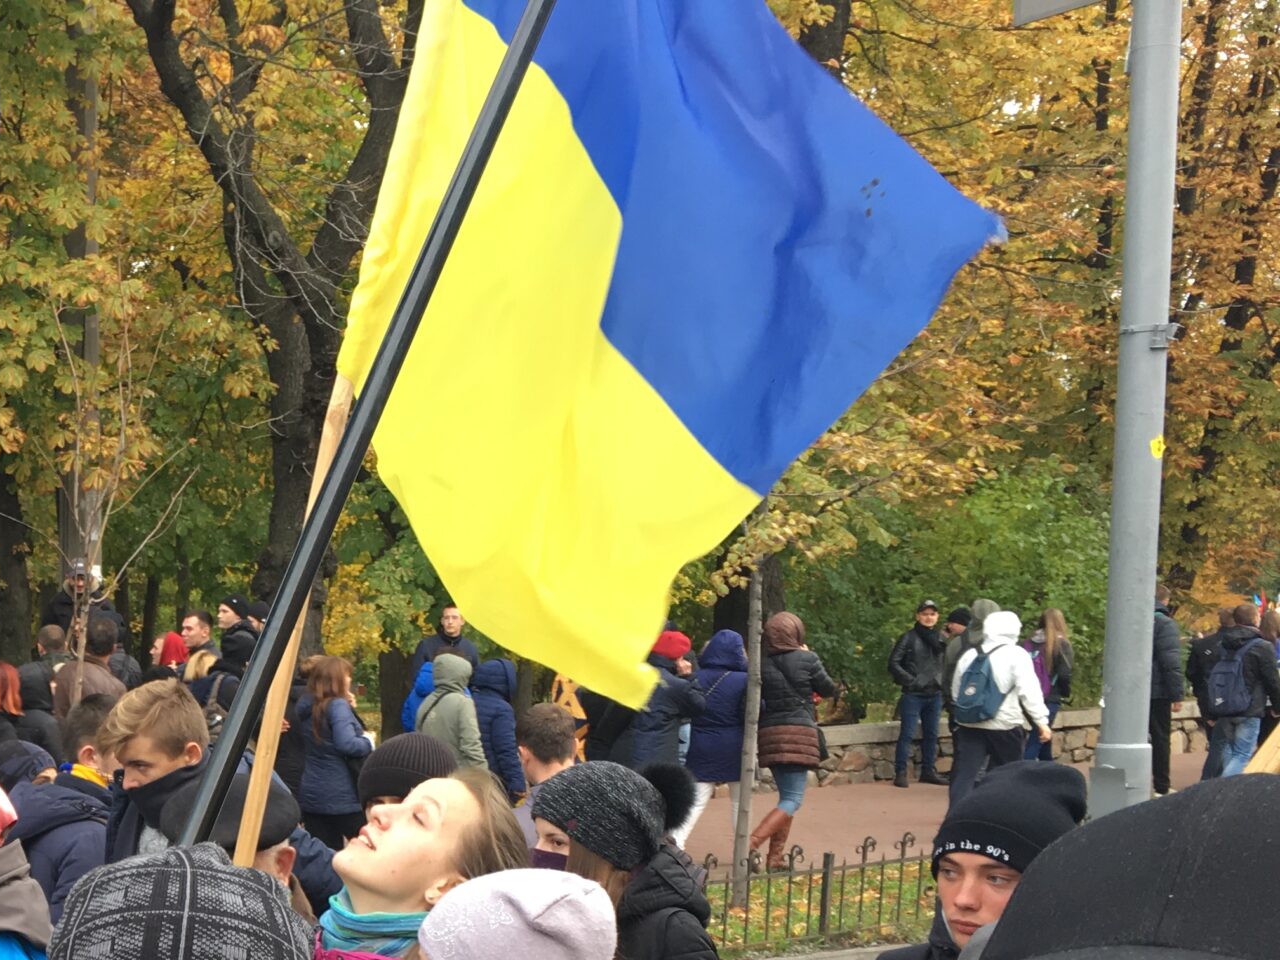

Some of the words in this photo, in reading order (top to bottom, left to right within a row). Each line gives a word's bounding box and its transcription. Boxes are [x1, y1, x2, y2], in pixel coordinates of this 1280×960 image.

[945, 841, 956, 850] in
[960, 839, 981, 851] the
[986, 845, 1010, 861] 90's
